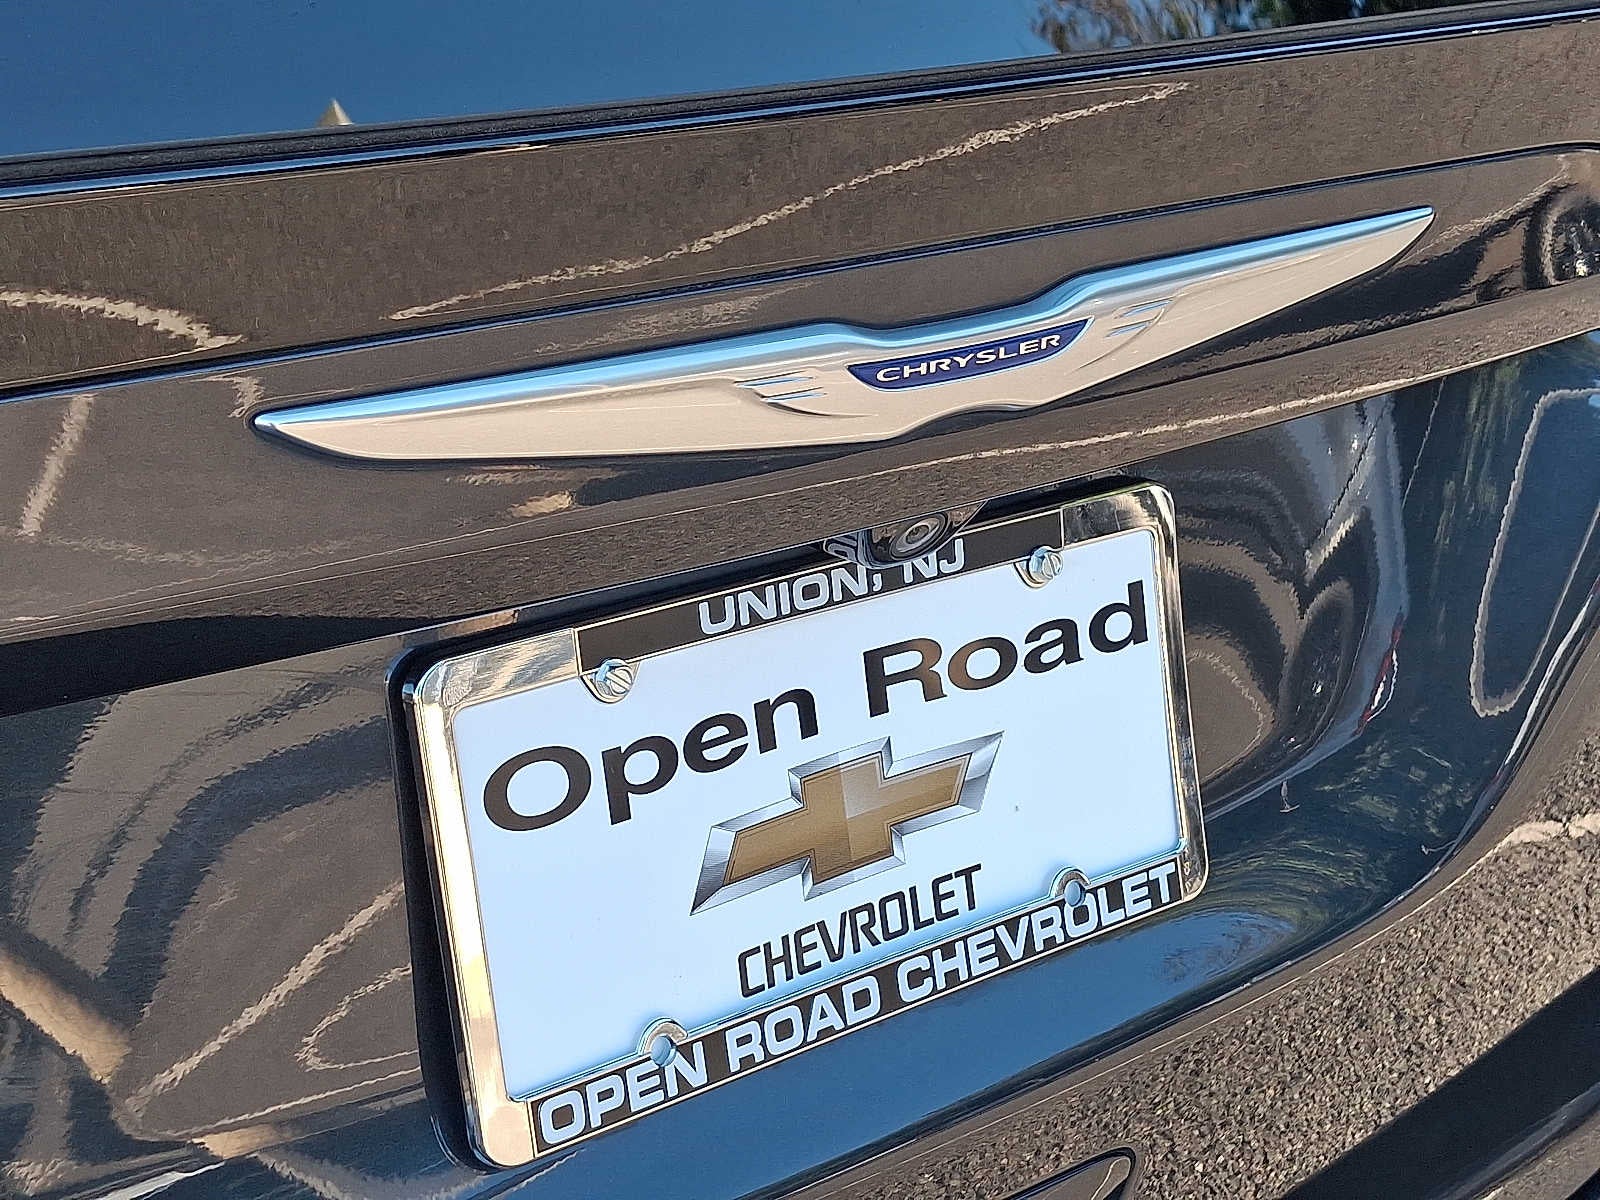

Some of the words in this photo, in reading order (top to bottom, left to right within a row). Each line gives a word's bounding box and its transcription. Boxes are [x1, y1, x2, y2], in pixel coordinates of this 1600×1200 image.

[875, 333, 1062, 383] CHRYSLER
[698, 563, 882, 636] UNION,
[902, 537, 966, 585] NJ
[482, 687, 819, 832] Open
[863, 580, 1149, 718] Road
[736, 863, 984, 1000] CHEVROLET
[538, 1040, 709, 1145] OPEN
[725, 975, 883, 1075] ROAD
[895, 861, 1178, 1002] CHEVROLET
